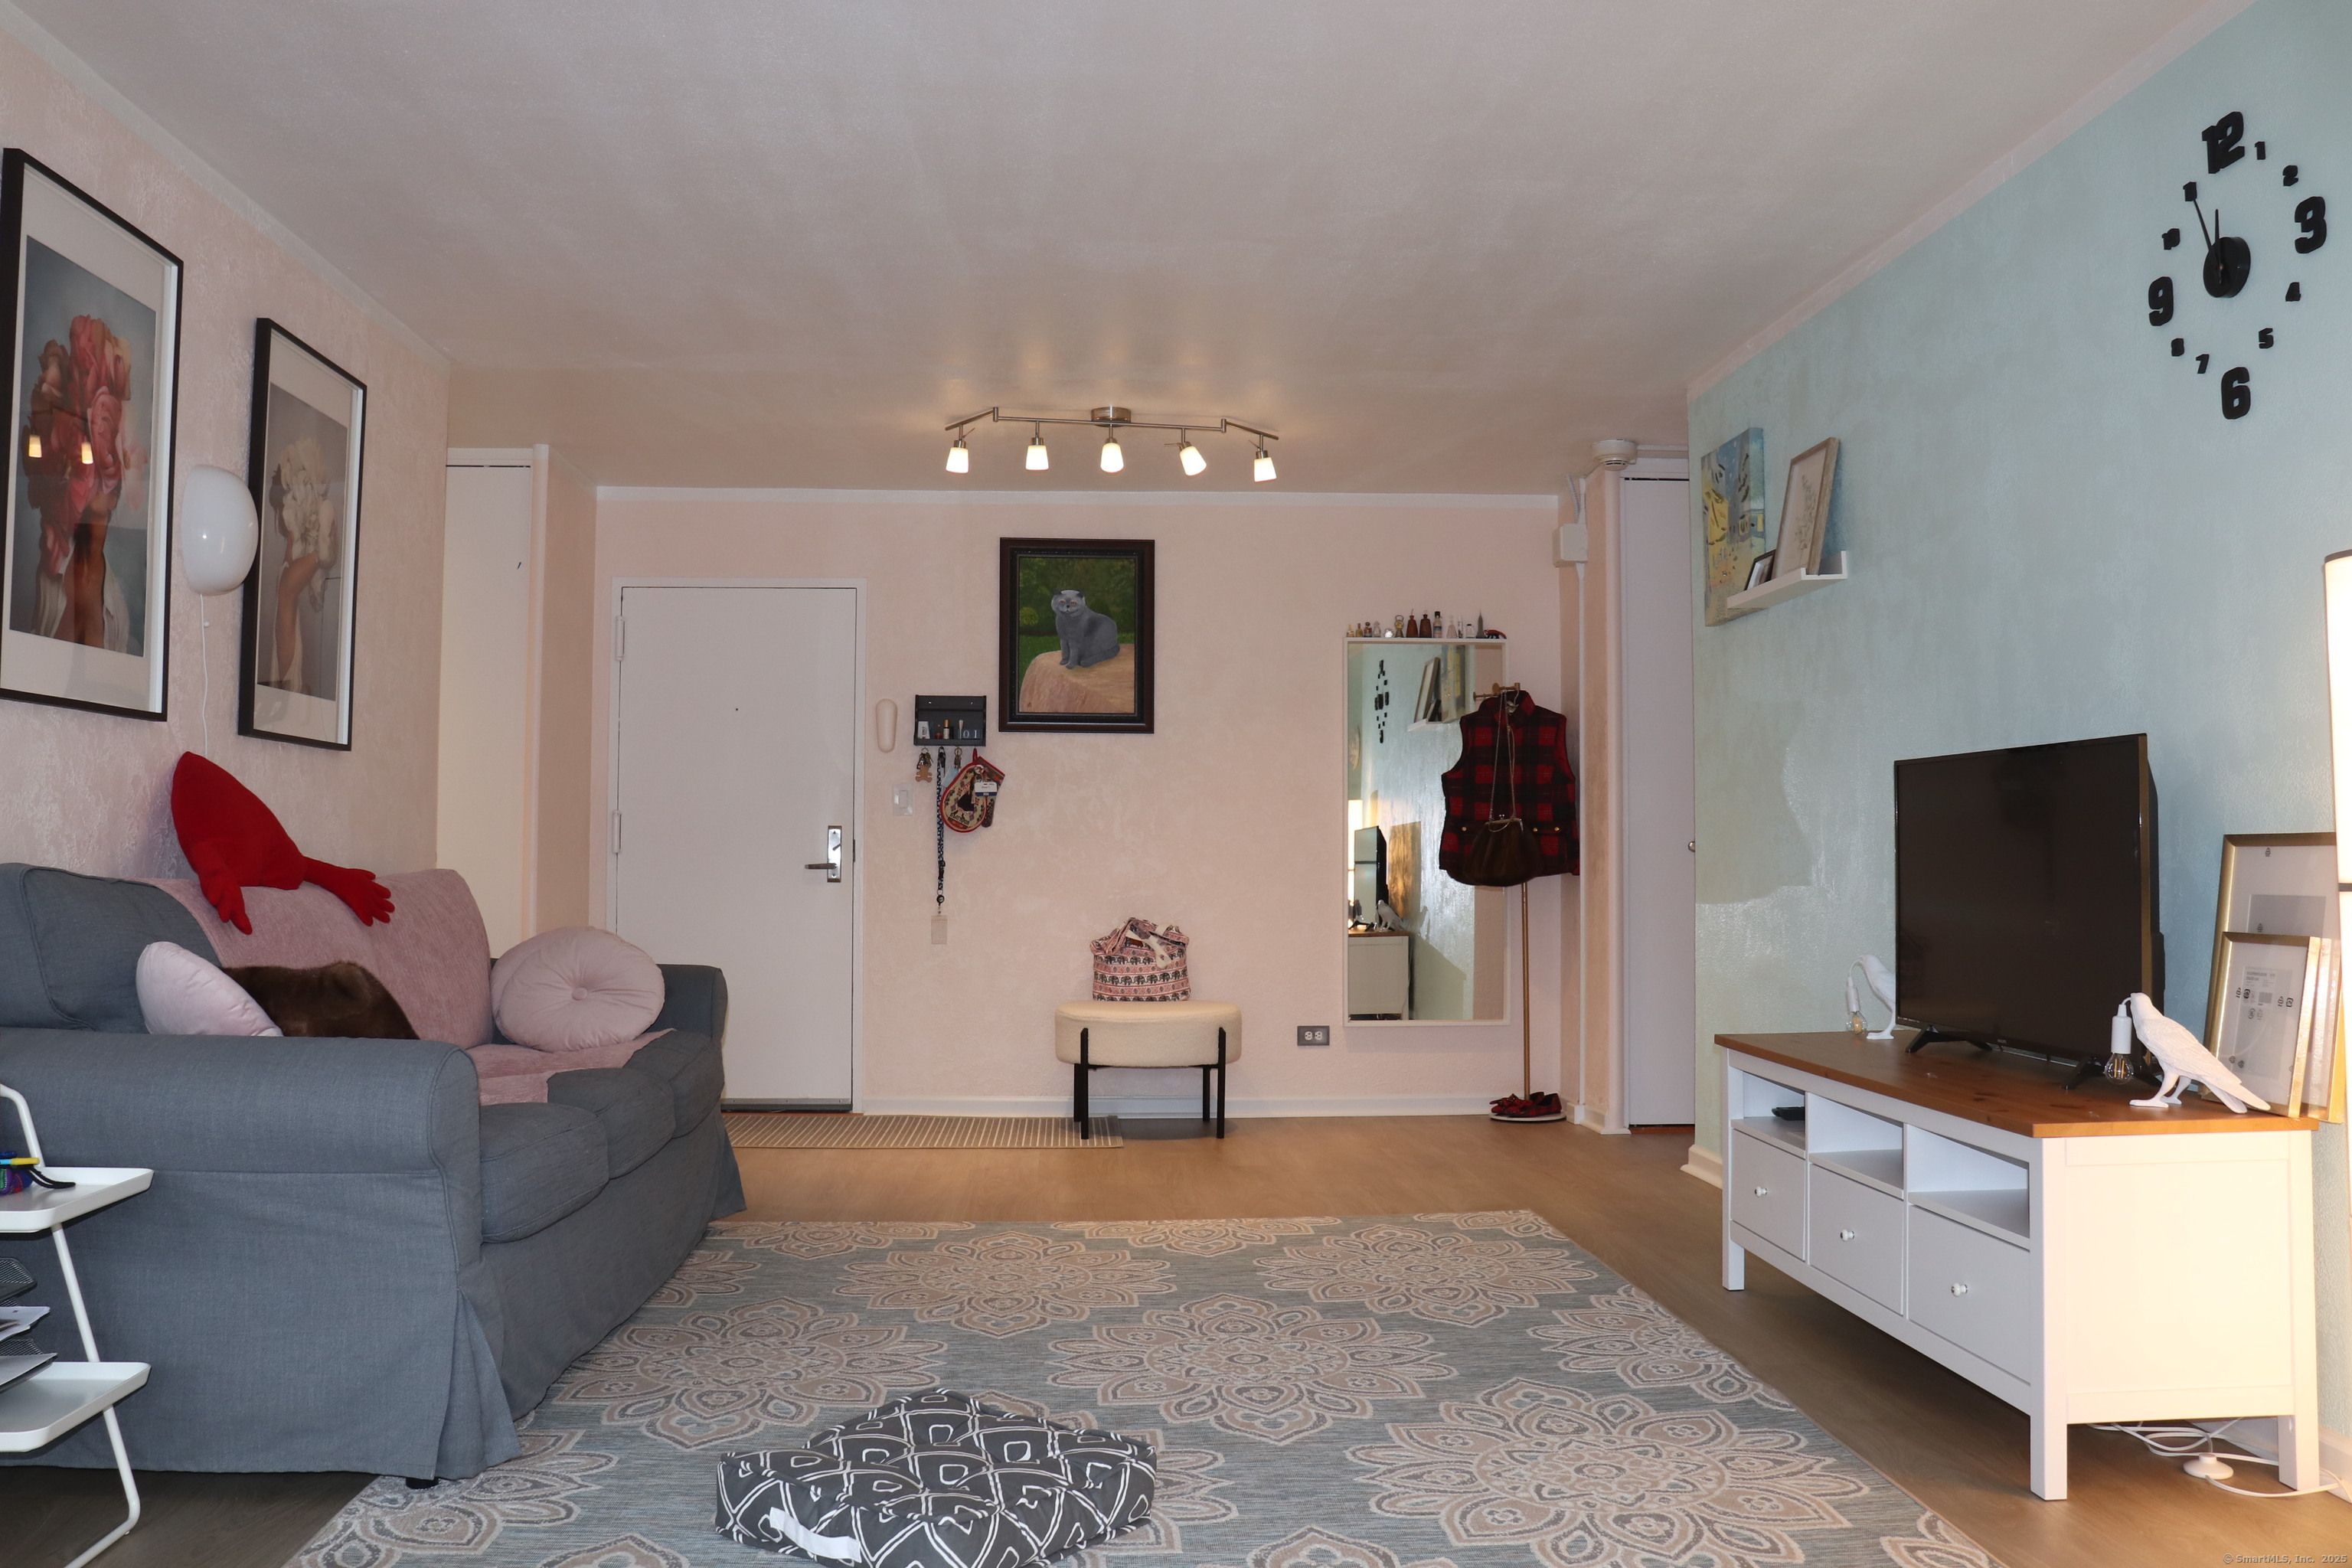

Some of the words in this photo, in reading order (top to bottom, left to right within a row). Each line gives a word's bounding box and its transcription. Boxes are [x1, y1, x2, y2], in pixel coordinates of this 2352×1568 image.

[2202, 111, 2245, 174] 12
[2255, 141, 2266, 160] 1
[2282, 165, 2299, 186] 2
[2295, 196, 2327, 253] 3
[2148, 276, 2174, 326] 9
[2285, 282, 2301, 302] 4
[2171, 338, 2185, 357] 8
[2258, 328, 2274, 348] 5
[2195, 354, 2210, 374] 7
[2221, 367, 2251, 420] 6
